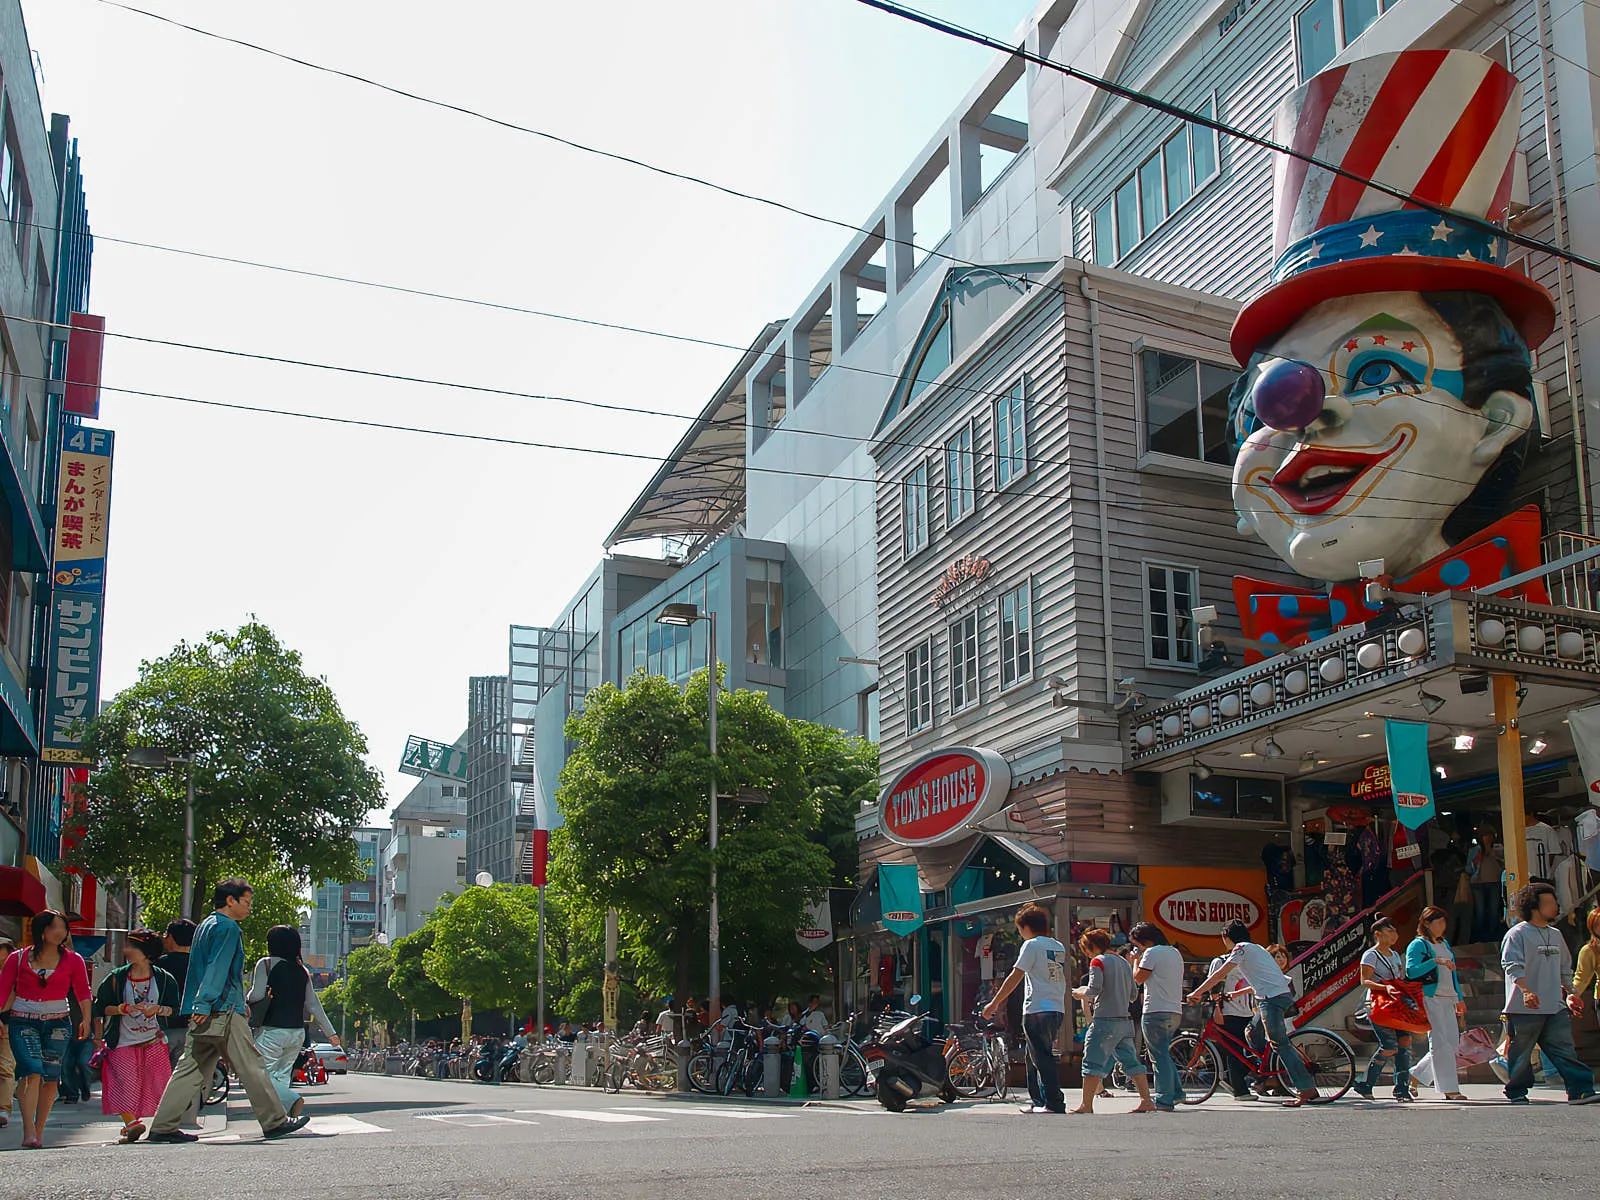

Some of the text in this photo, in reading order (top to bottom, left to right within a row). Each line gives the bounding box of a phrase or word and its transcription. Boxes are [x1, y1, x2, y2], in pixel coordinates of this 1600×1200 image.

[70, 431, 106, 452] 4F
[61, 462, 86, 549] まんが喫茶
[89, 465, 106, 544] インターネット
[1364, 765, 1390, 779] Cas
[1374, 775, 1391, 790] St
[892, 765, 976, 827] TOM'S HOUSE
[1168, 899, 1251, 923] TOM'S HOUSE
